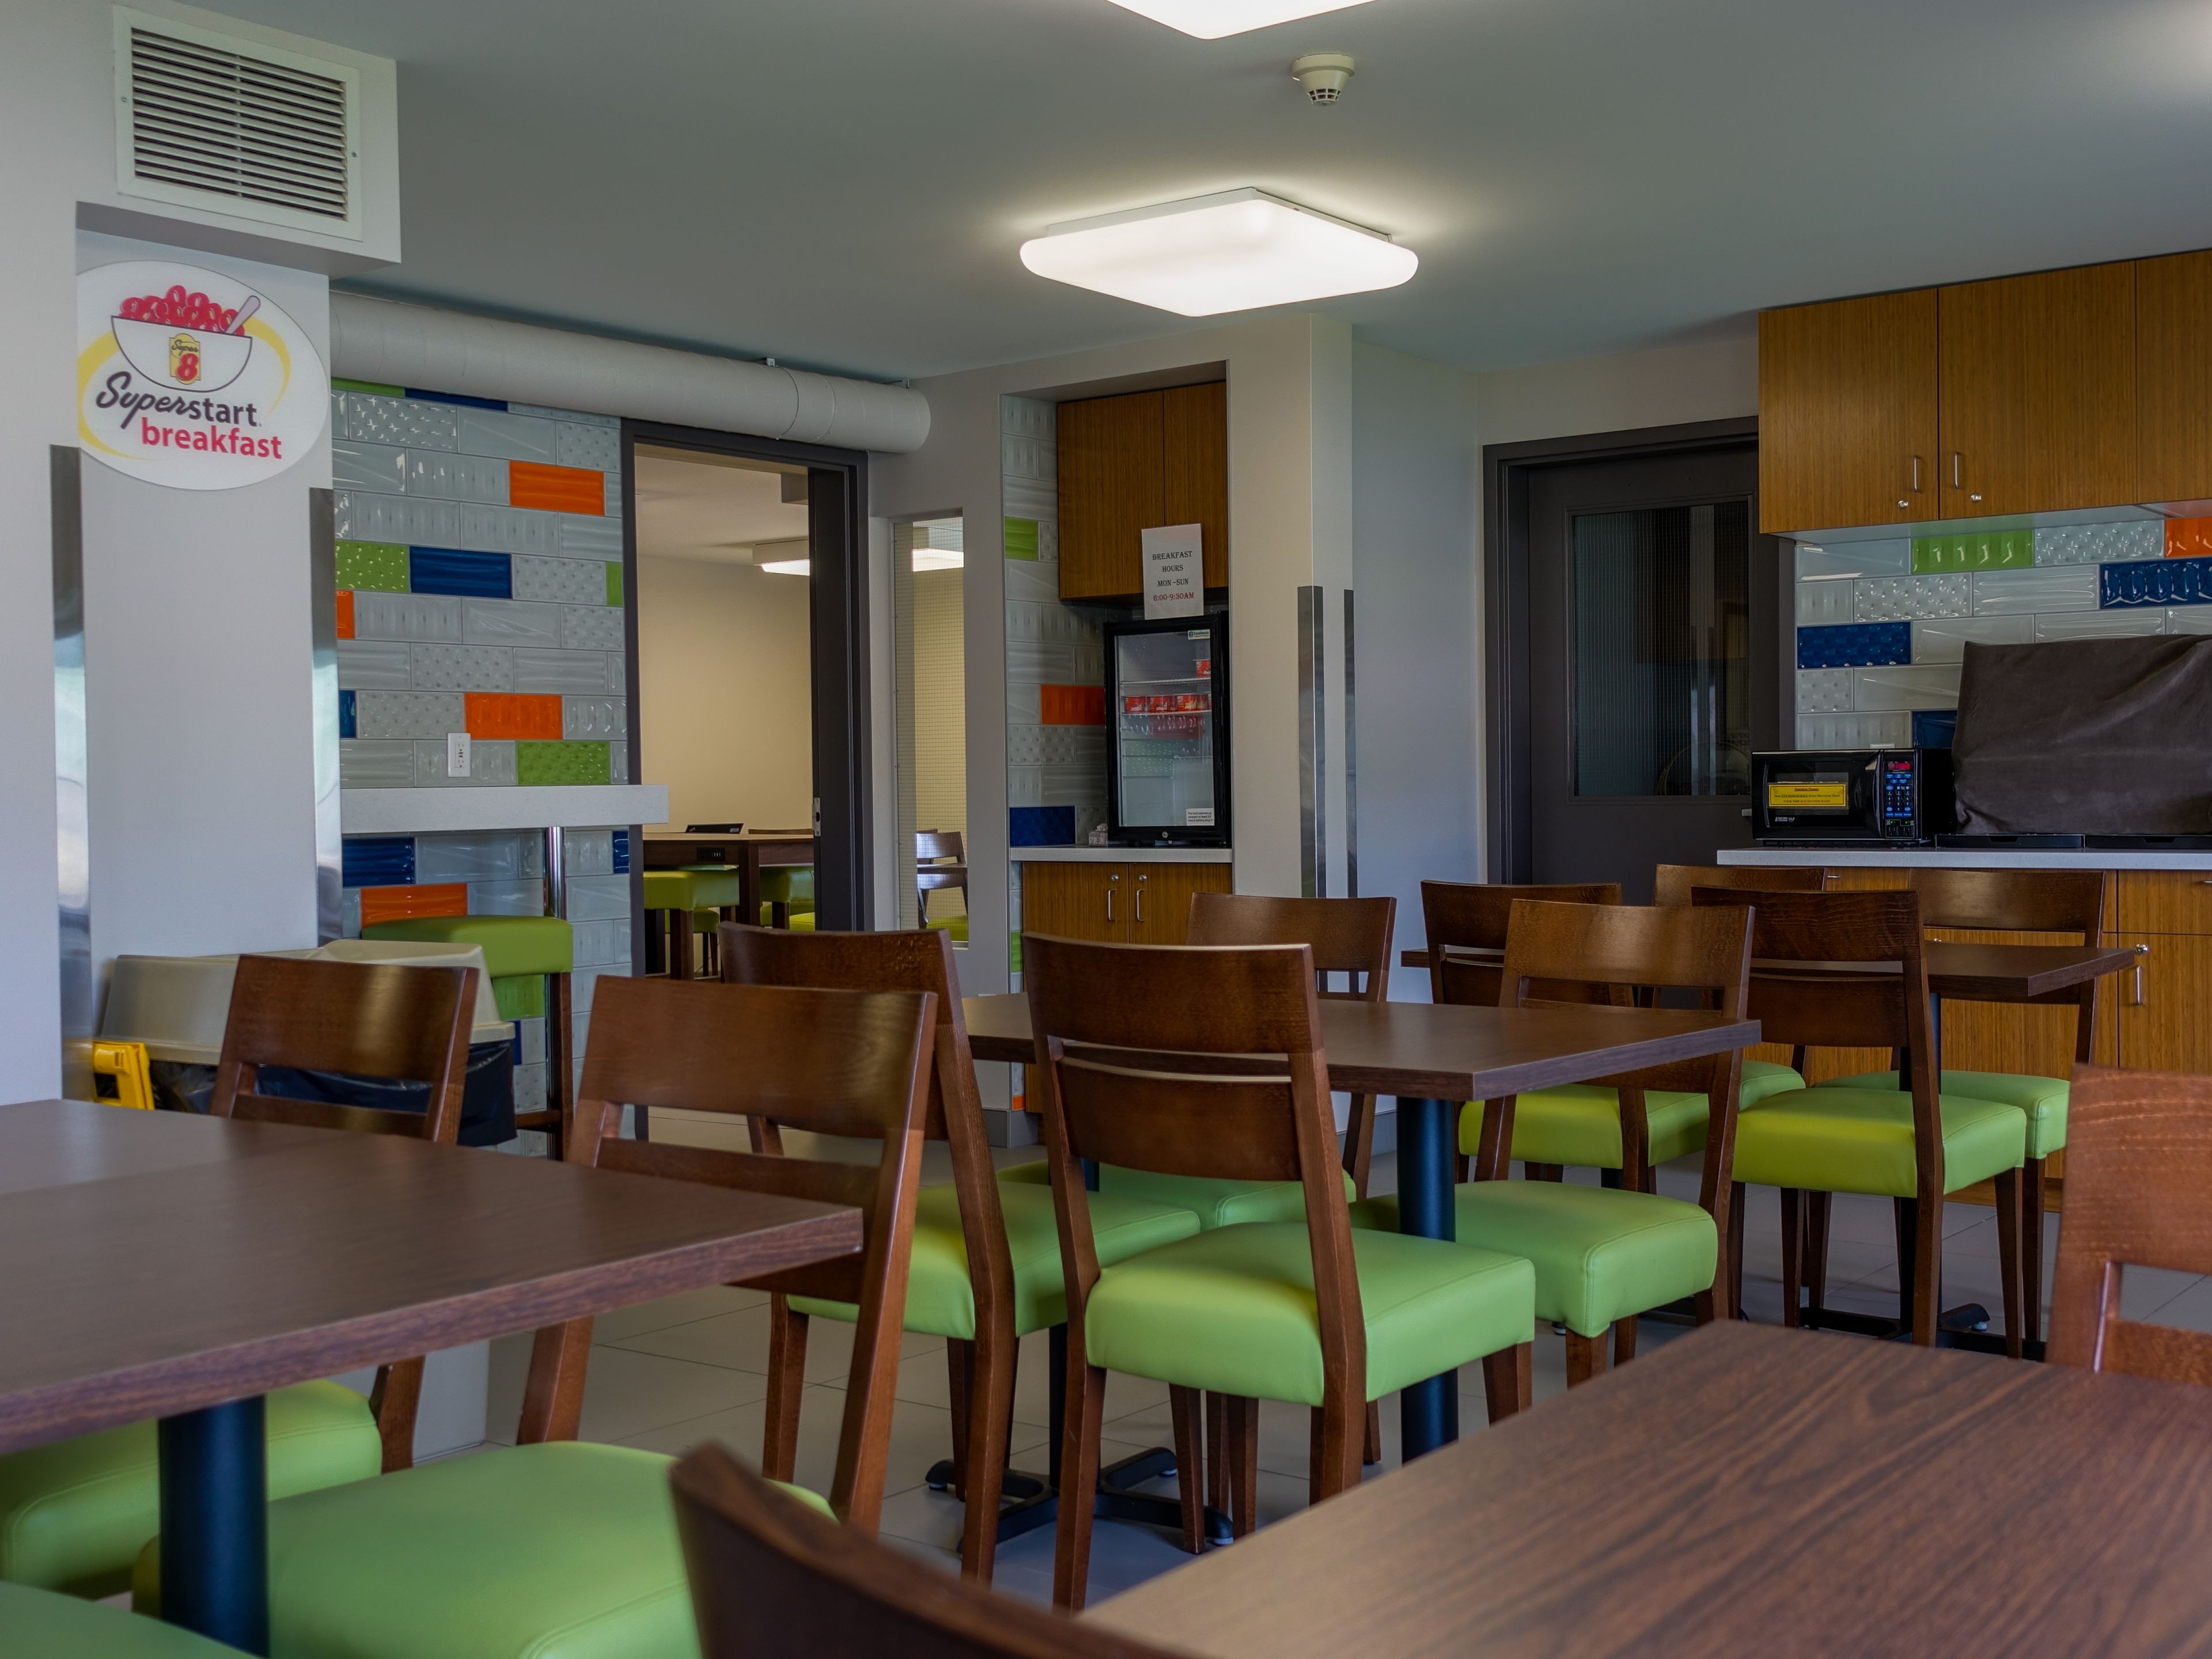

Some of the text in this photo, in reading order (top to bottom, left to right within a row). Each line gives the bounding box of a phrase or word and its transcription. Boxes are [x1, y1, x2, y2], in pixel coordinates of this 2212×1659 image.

[171, 339, 199, 356] Super
[176, 353, 199, 381] 8
[96, 371, 257, 430] Superstart
[141, 416, 282, 460] breakfast
[1152, 551, 1193, 560] BREAKFAST
[1162, 565, 1184, 573] HOURS
